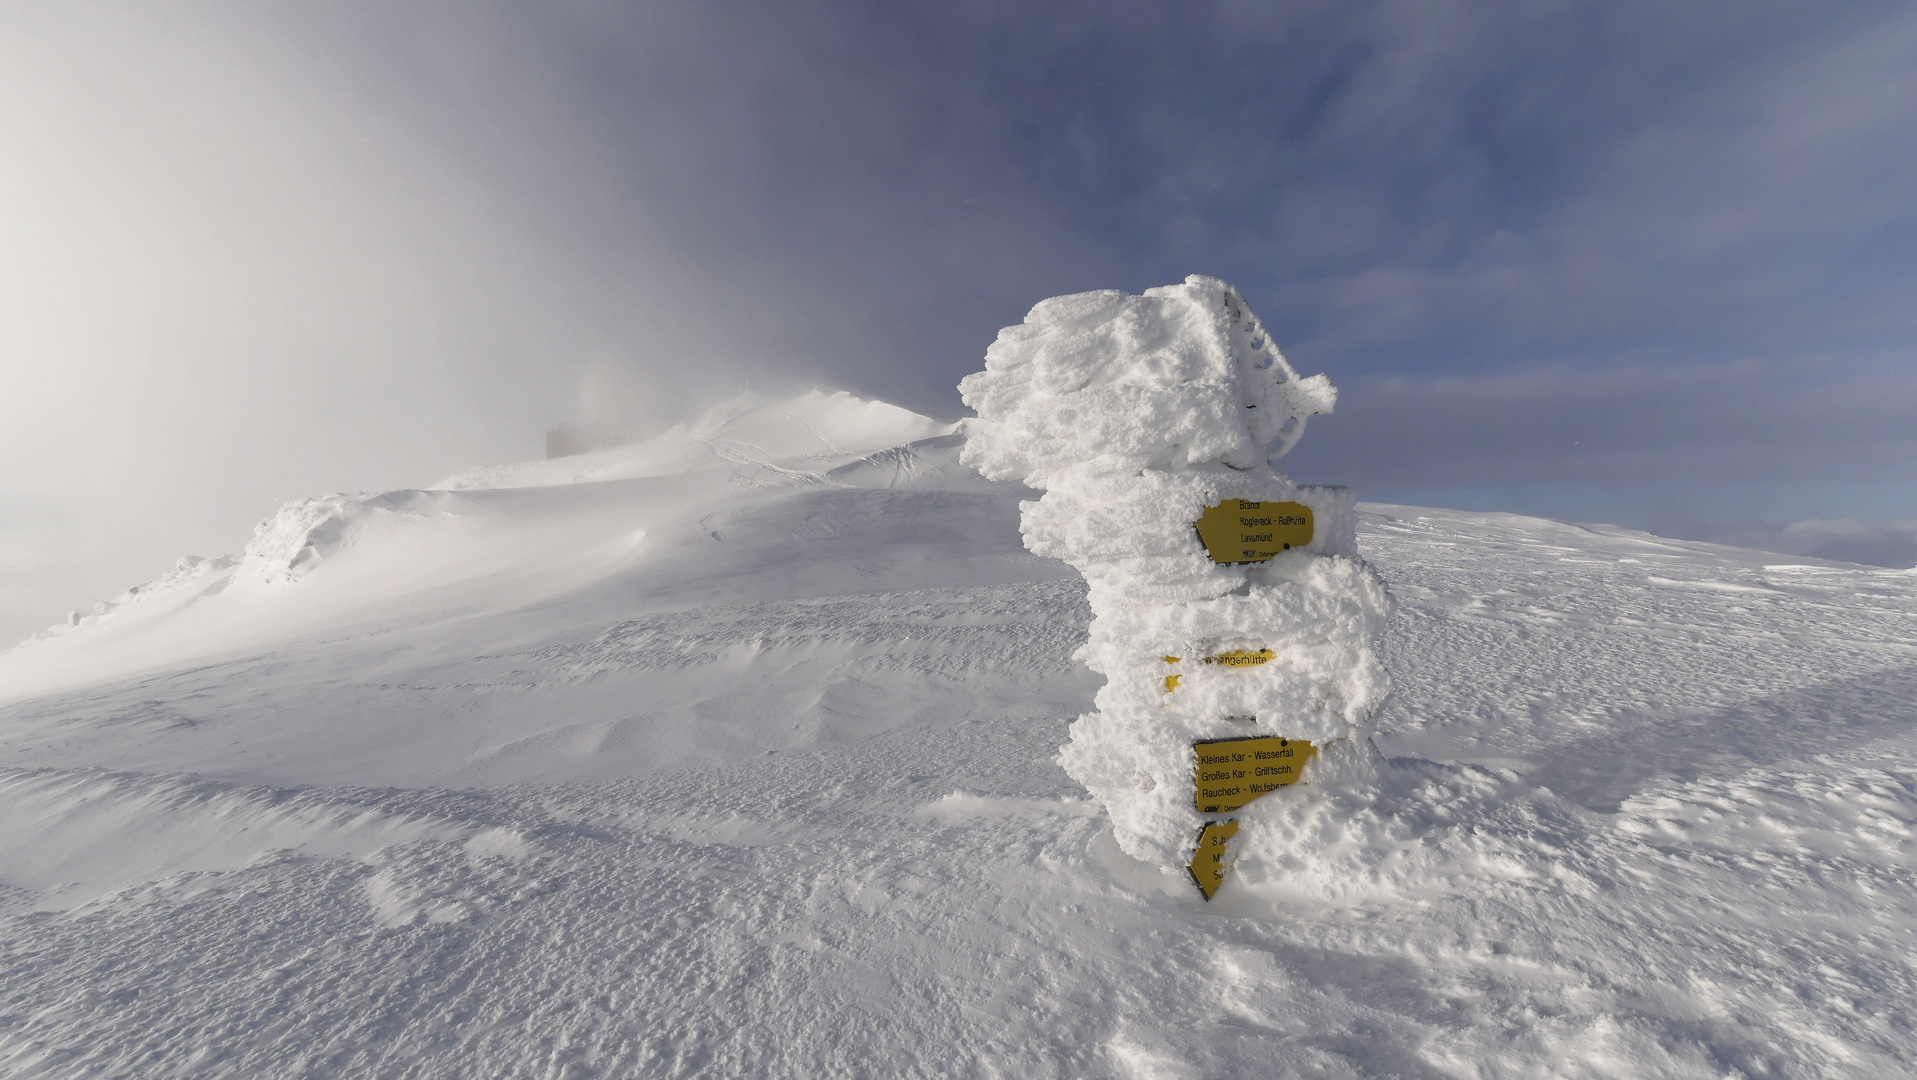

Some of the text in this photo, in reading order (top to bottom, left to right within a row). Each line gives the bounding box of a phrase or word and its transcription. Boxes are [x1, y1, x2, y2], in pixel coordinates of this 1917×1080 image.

[1240, 517, 1272, 527] Koglereck
[1201, 755, 1230, 765] Kleines
[1232, 752, 1246, 762] Kar
[1254, 748, 1294, 760] Wasserfall
[1201, 771, 1230, 782] Großes
[1232, 769, 1246, 779] Kar
[1202, 785, 1241, 798] Raucheck
